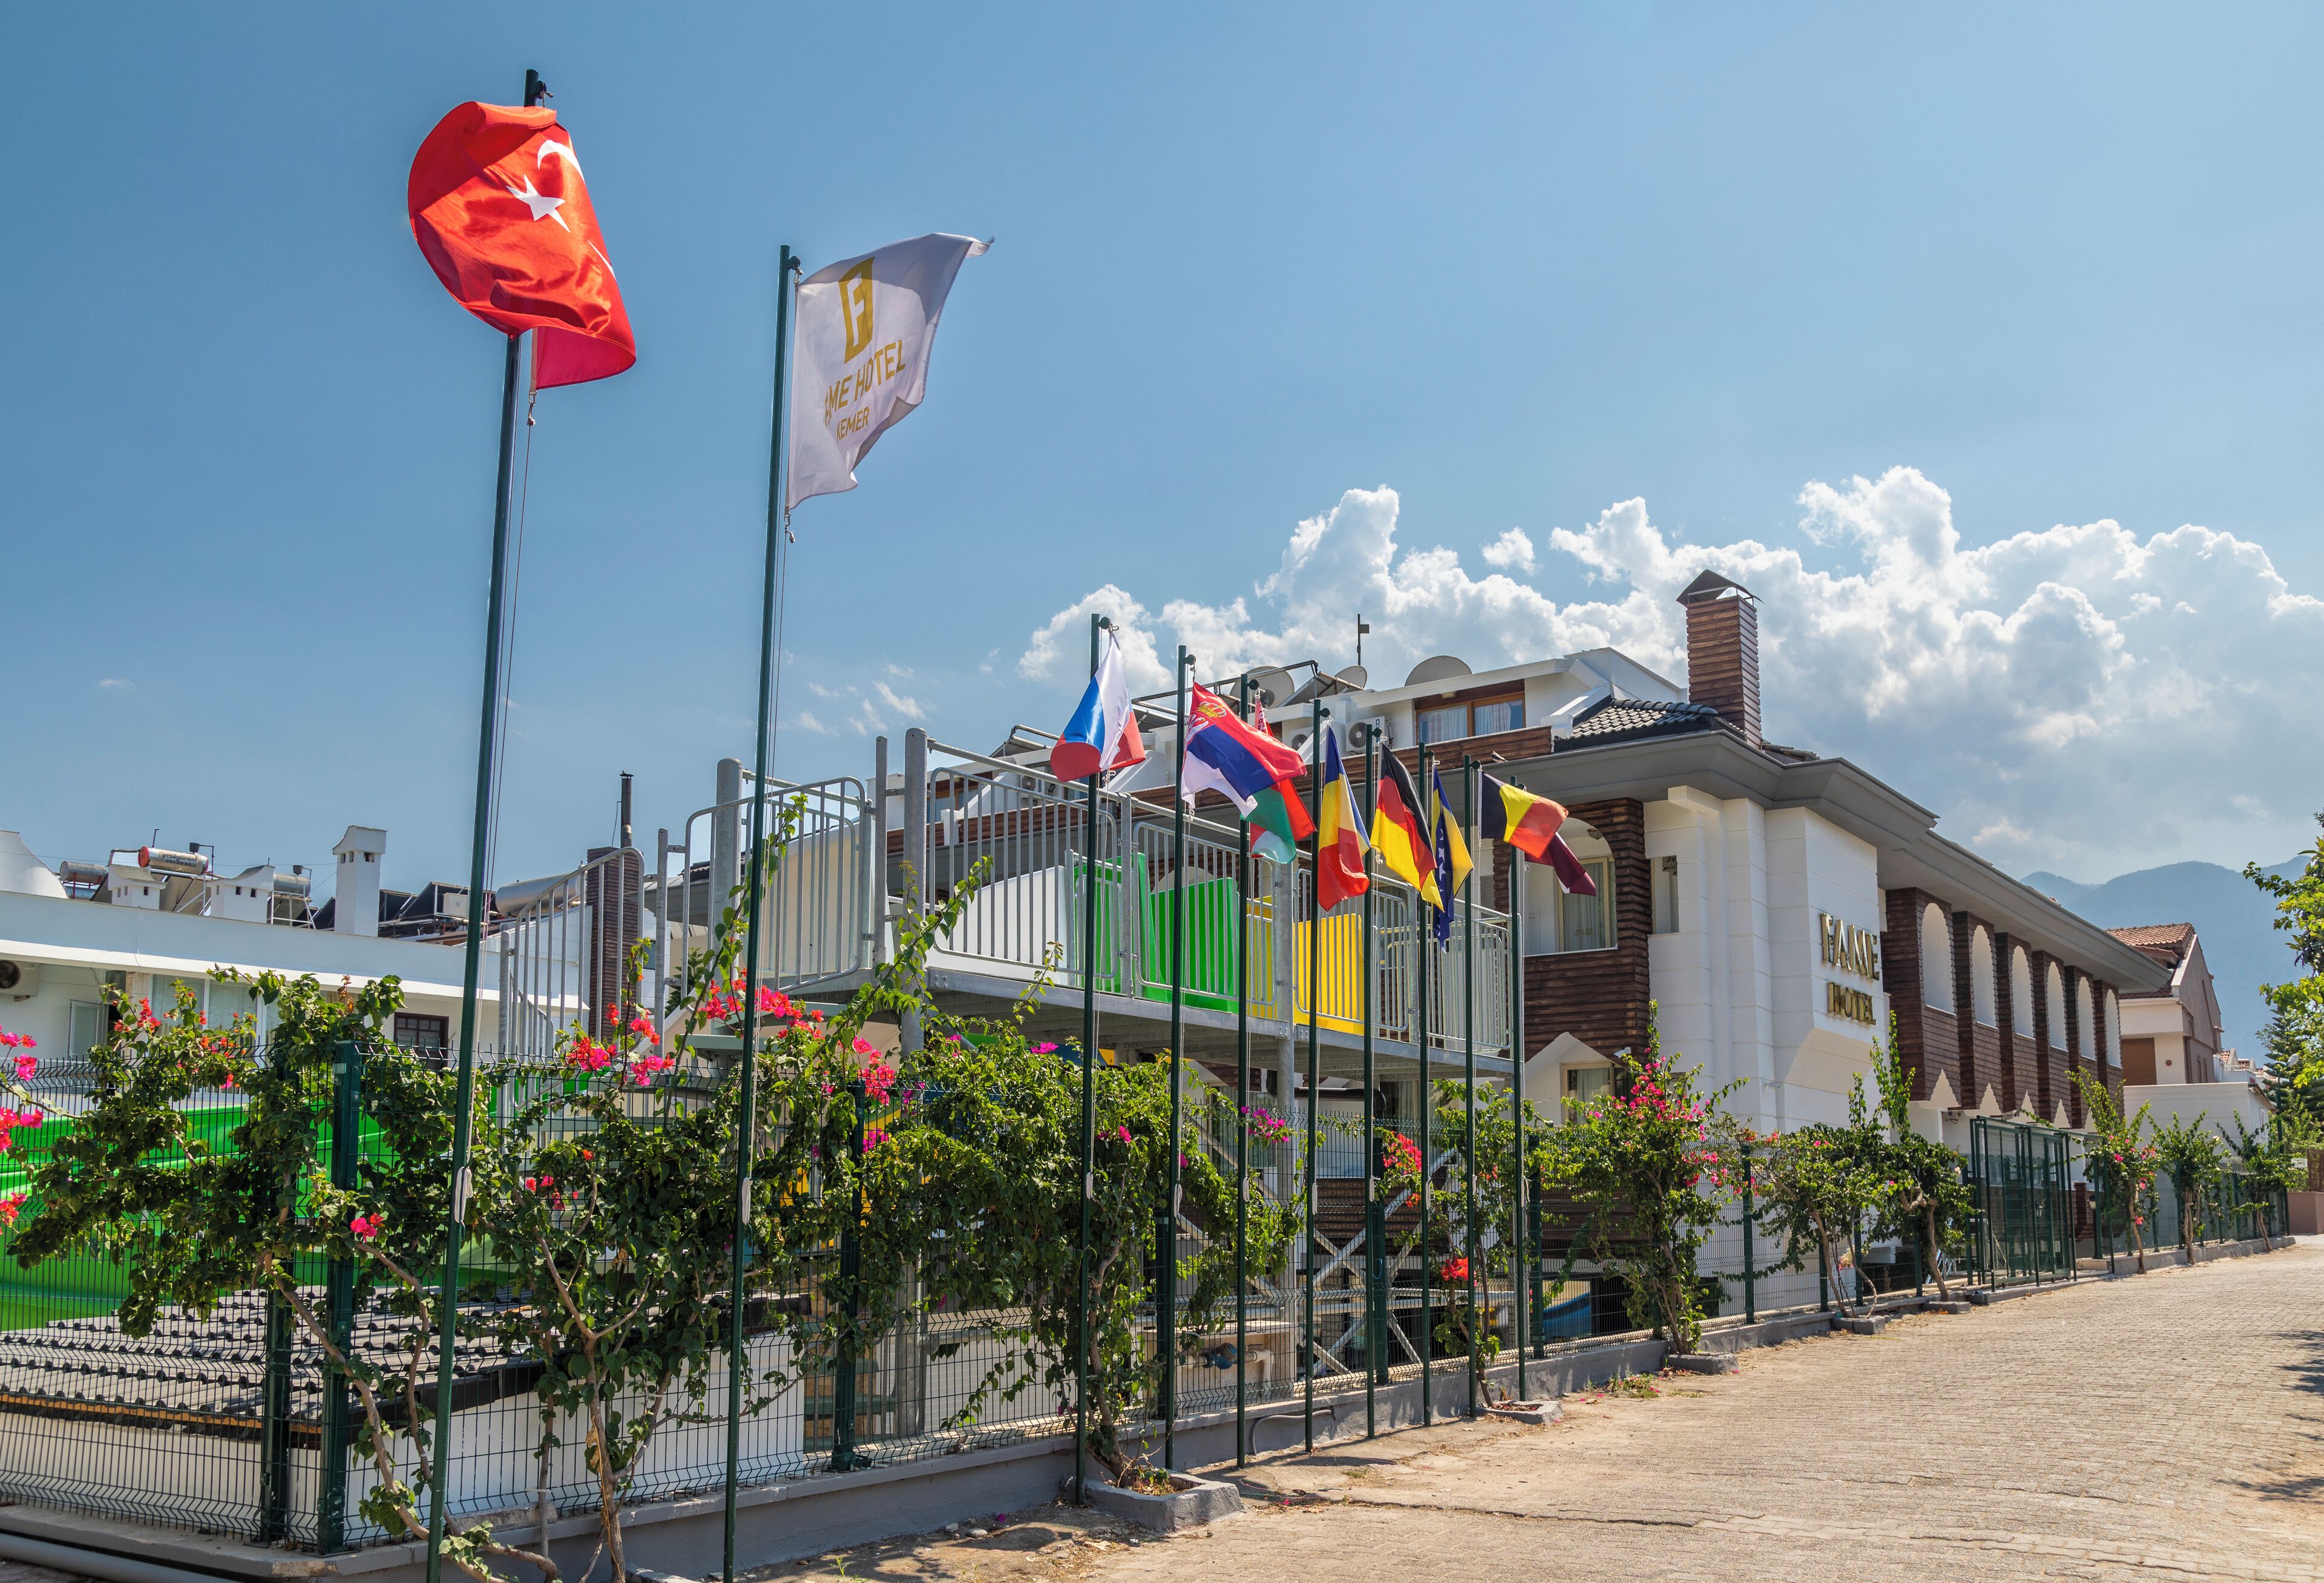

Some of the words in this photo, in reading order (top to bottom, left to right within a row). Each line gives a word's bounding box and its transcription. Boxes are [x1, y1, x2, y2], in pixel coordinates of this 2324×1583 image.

[824, 374, 853, 430] AME
[854, 339, 906, 402] HOTEL
[836, 406, 870, 444] KEMER
[1820, 912, 1880, 981] FAME
[1827, 982, 1876, 1025] HOTEL
